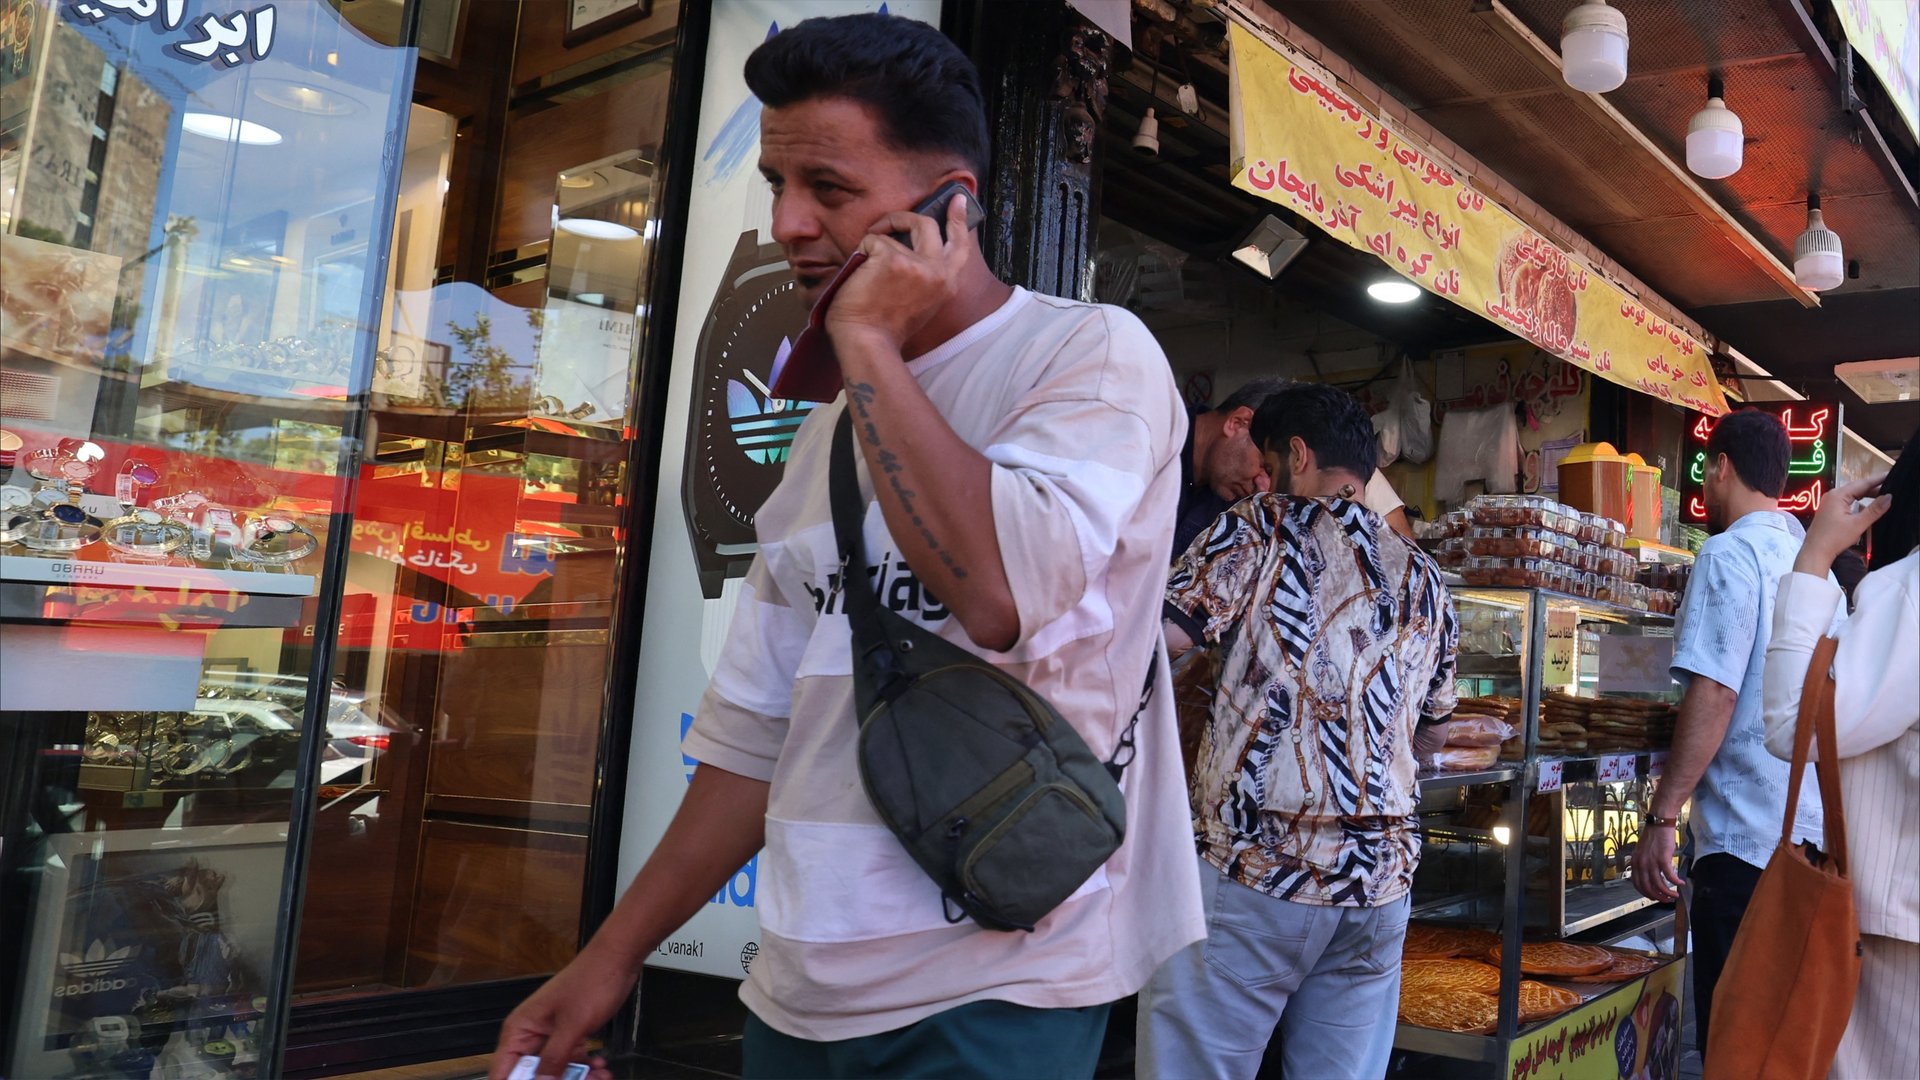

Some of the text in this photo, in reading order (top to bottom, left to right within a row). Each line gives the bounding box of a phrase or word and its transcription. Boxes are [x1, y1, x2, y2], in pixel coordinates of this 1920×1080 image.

[1248, 160, 1362, 233] آذربایجان
[1422, 210, 1461, 251] انواع
[1434, 270, 1460, 295] نان
[1567, 269, 1588, 292] نان
[1620, 299, 1695, 357] کلوچه اصل فومن
[1595, 350, 1612, 372] نان
[1690, 370, 1708, 388] نان
[51, 563, 105, 576] OBAKU
